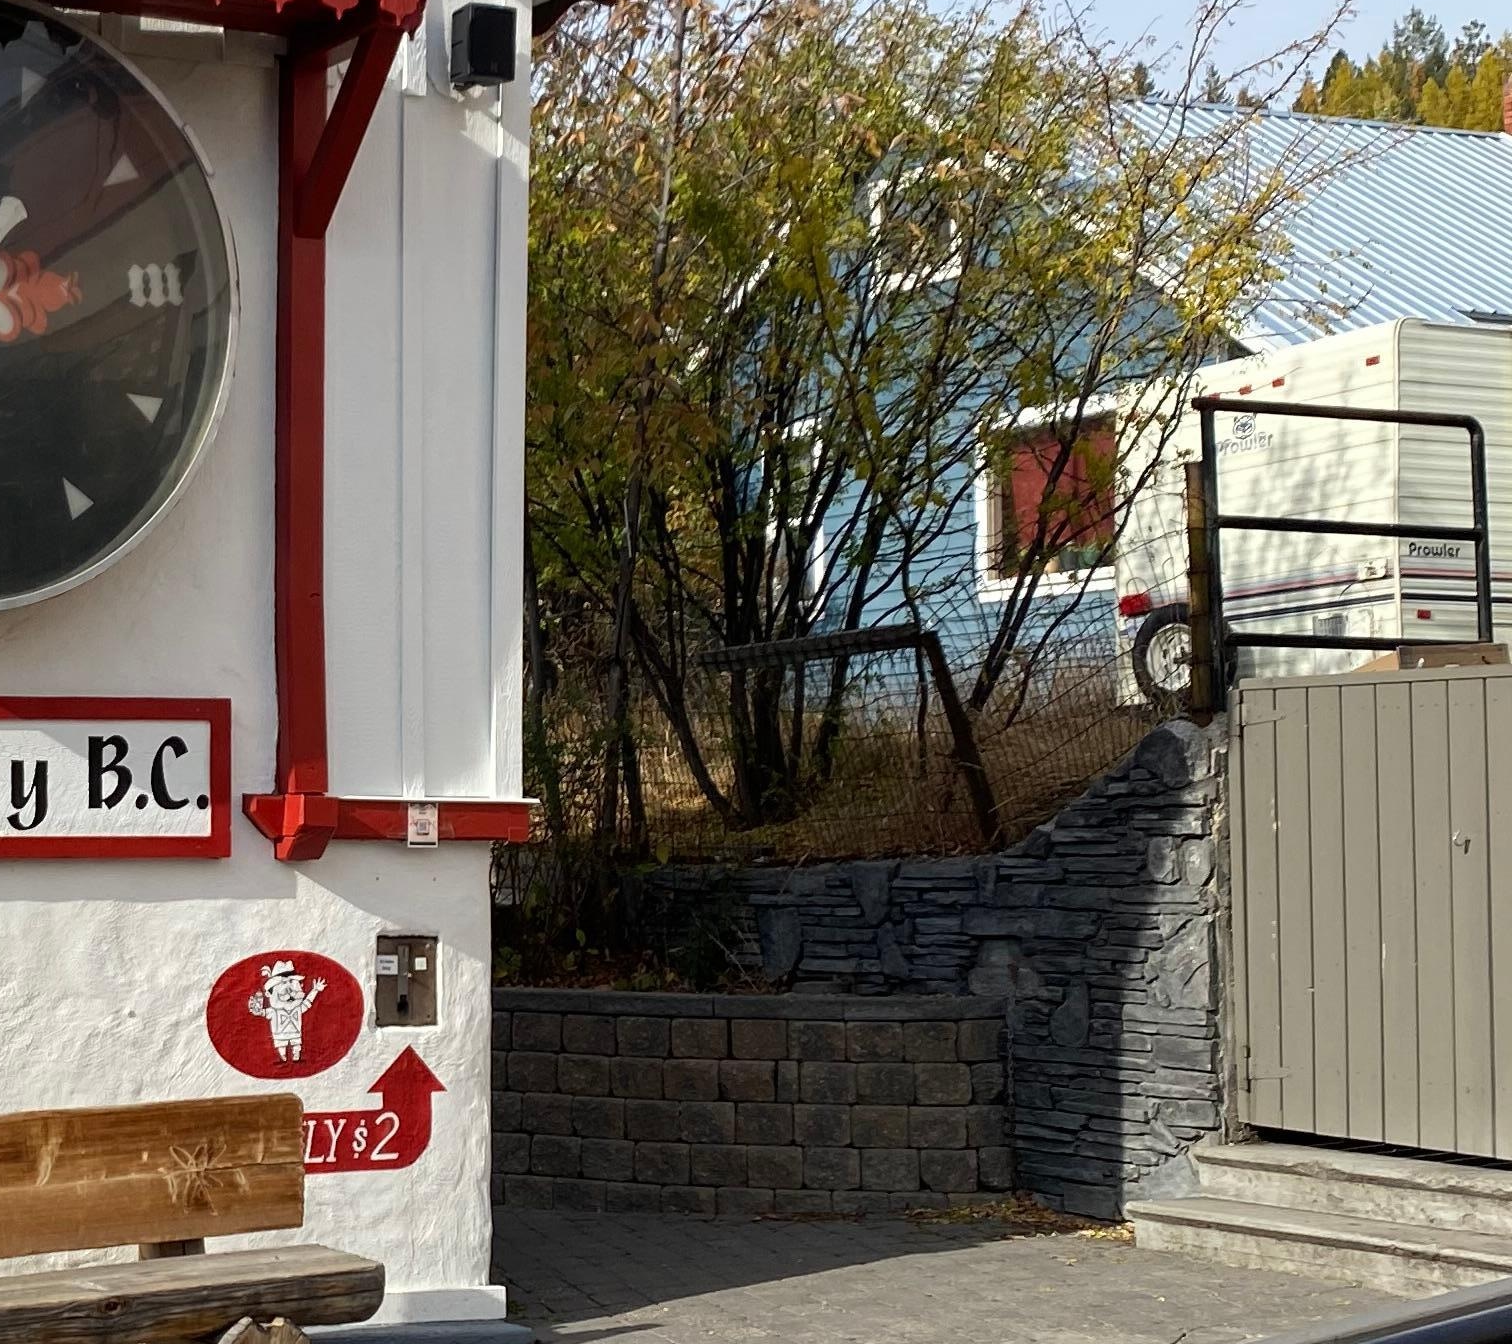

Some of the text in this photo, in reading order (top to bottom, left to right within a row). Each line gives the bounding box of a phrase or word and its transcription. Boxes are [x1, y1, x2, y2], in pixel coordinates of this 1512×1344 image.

[128, 263, 183, 307] III
[1409, 542, 1461, 558] Prowler
[88, 734, 211, 811] B.C.
[303, 1118, 347, 1164] LY
